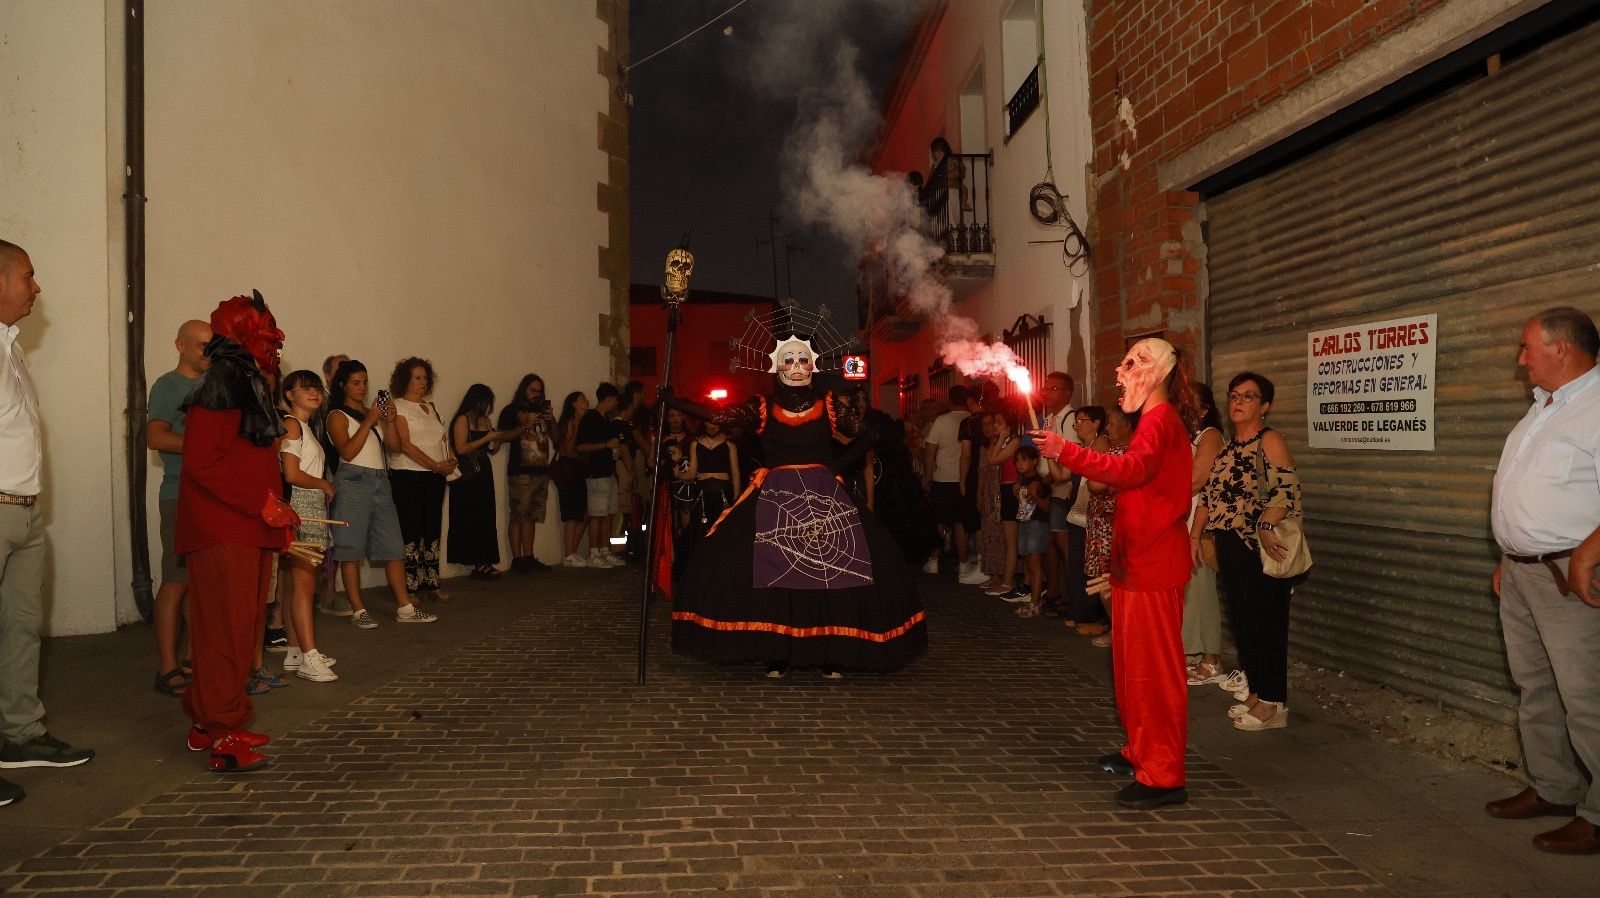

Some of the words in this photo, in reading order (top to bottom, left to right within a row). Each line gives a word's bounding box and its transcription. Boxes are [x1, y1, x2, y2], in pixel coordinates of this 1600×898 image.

[1312, 331, 1361, 357] CARLOS
[1368, 322, 1429, 350] TORRES
[1318, 353, 1405, 376] CONSTRUCCIONES
[1411, 352, 1419, 368] Y
[1312, 379, 1362, 396] REFORMAS
[1363, 378, 1377, 394] EN
[1379, 374, 1428, 393] GENERAL
[1340, 402, 1352, 413] 192
[1371, 401, 1384, 412] 678
[1385, 401, 1398, 411] 619
[1400, 400, 1414, 411] 966
[1312, 420, 1359, 432] VALVERDE
[1361, 420, 1374, 432] DE
[1377, 416, 1427, 432] LEGANÉS
